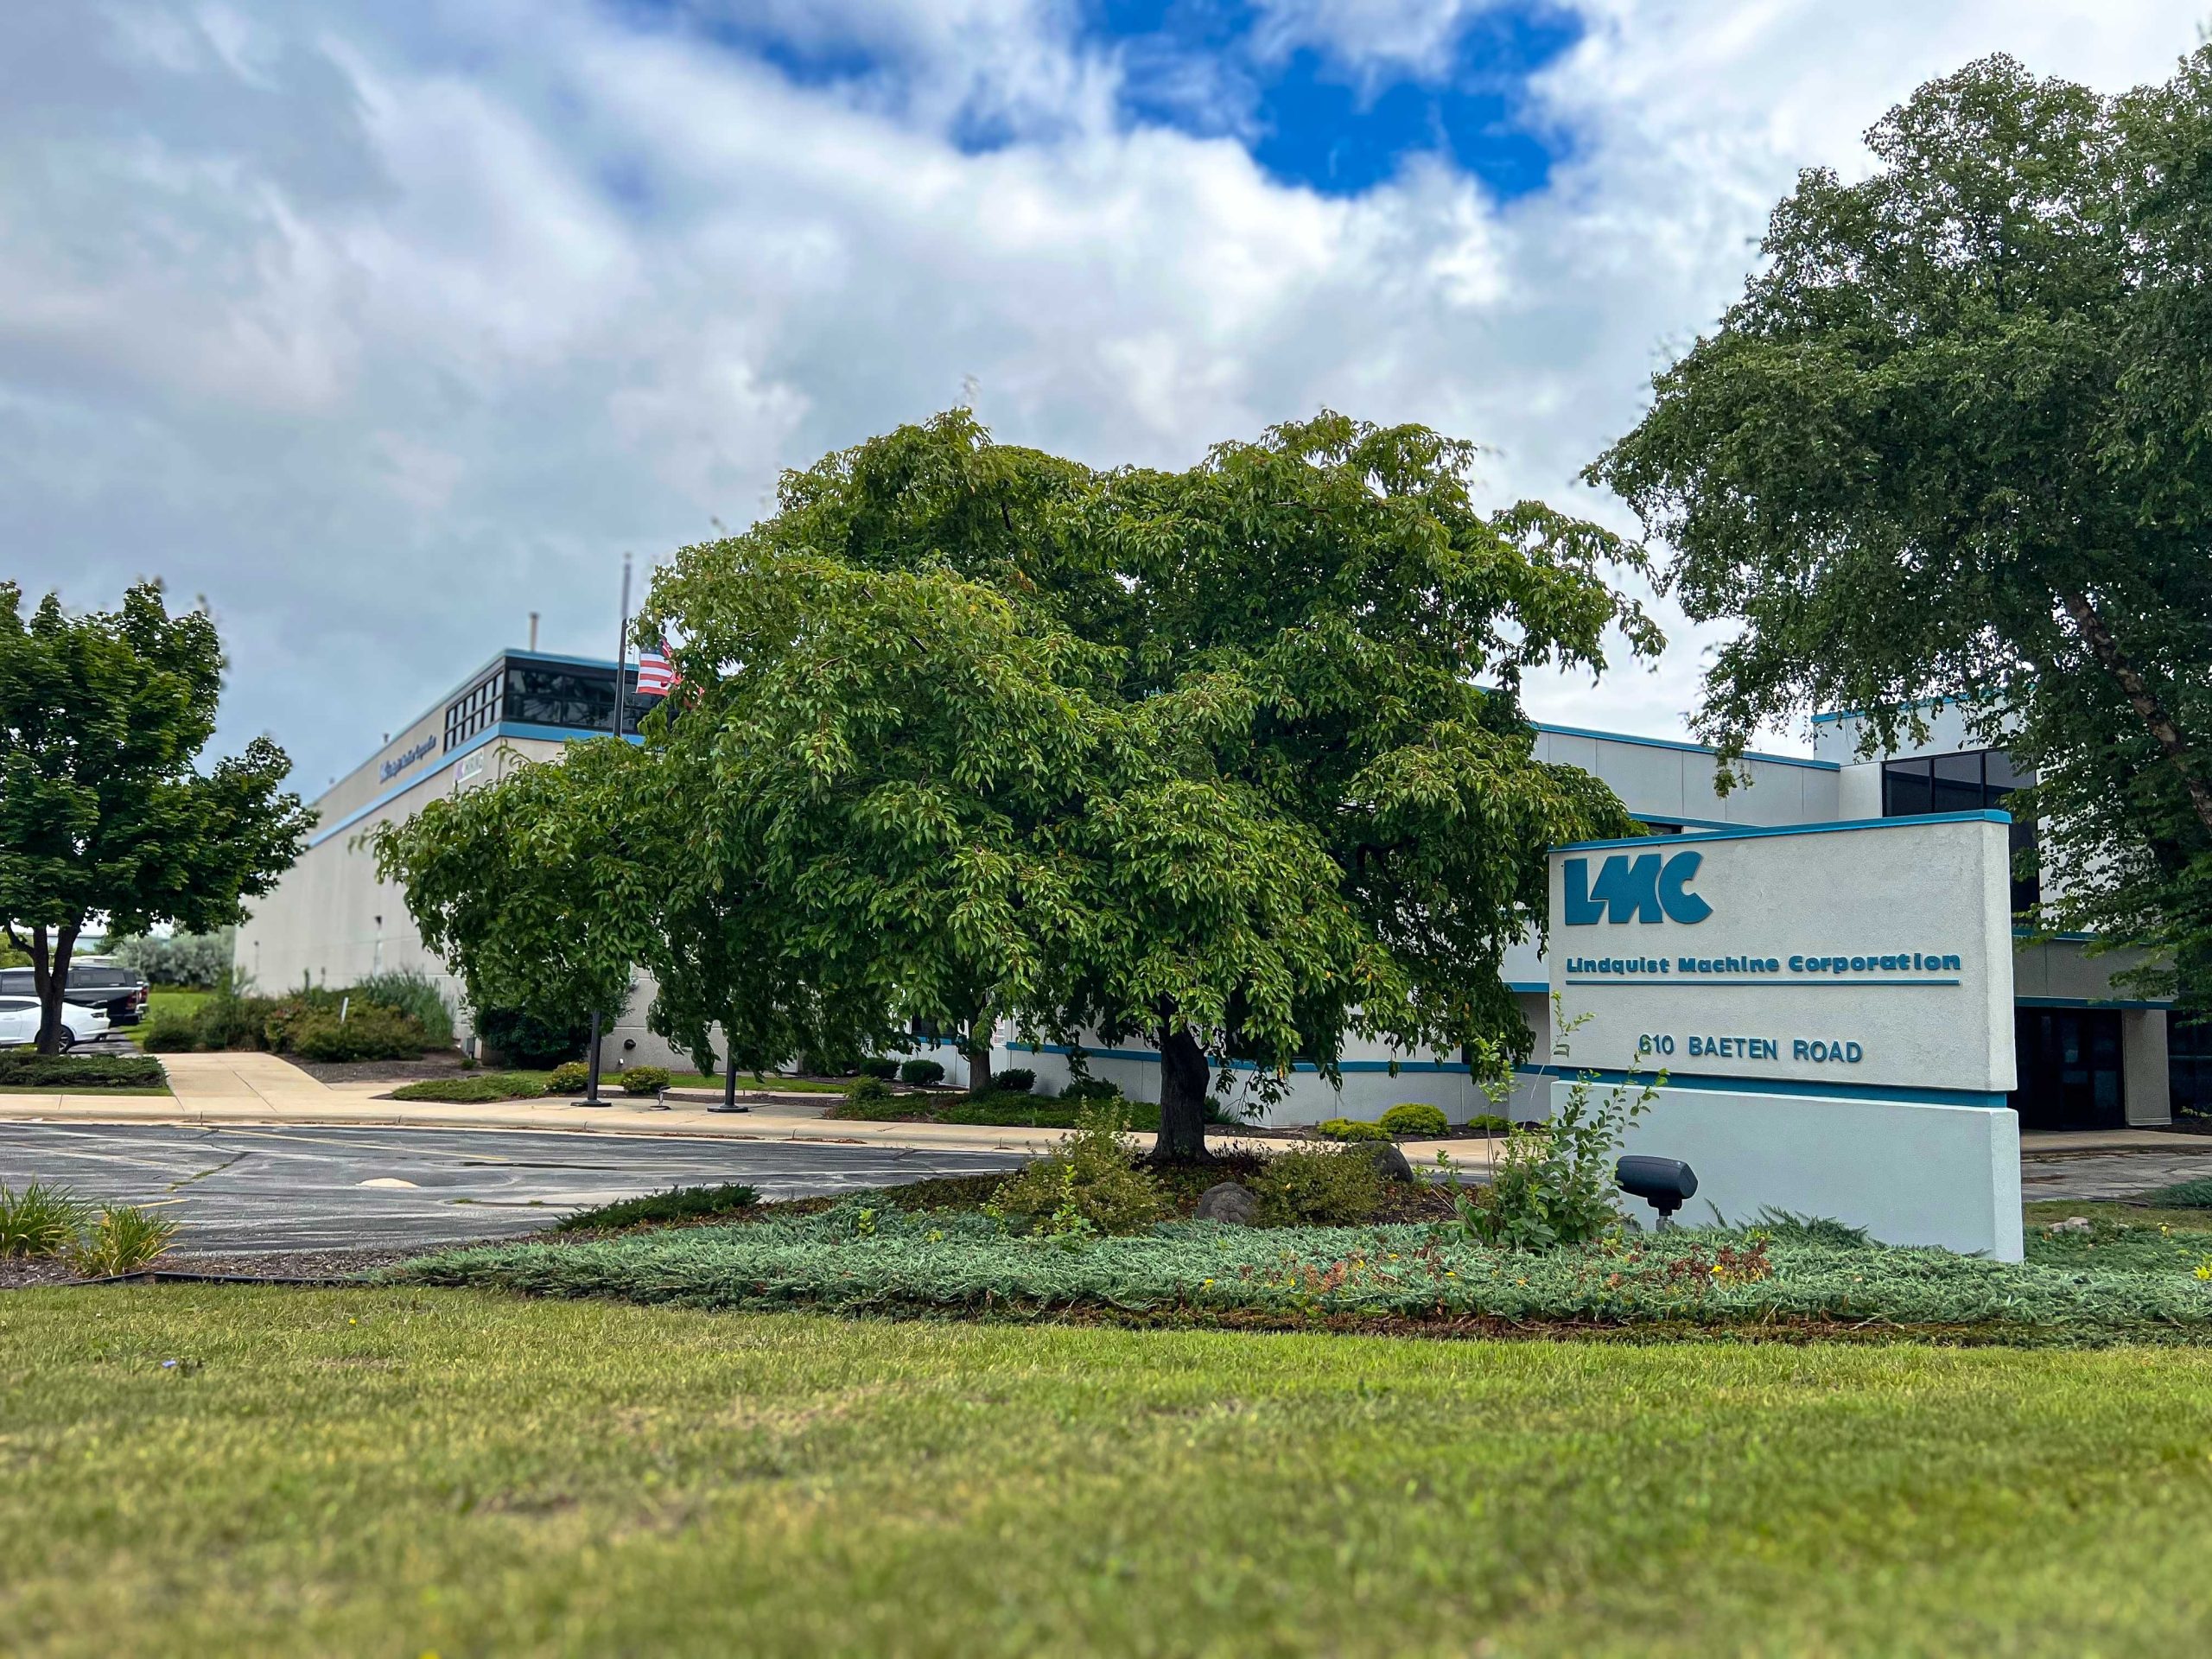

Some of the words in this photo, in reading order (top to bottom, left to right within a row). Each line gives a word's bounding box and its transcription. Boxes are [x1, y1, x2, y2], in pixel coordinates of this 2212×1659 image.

[1564, 850, 1713, 925] LMC
[1567, 957, 1670, 975] Lindquist
[1678, 956, 1780, 973] Machine
[1788, 952, 1961, 975] Corporation
[1638, 1034, 1675, 1055] 610
[1688, 1036, 1777, 1060] BAETEN
[1792, 1039, 1863, 1063] ROAD
